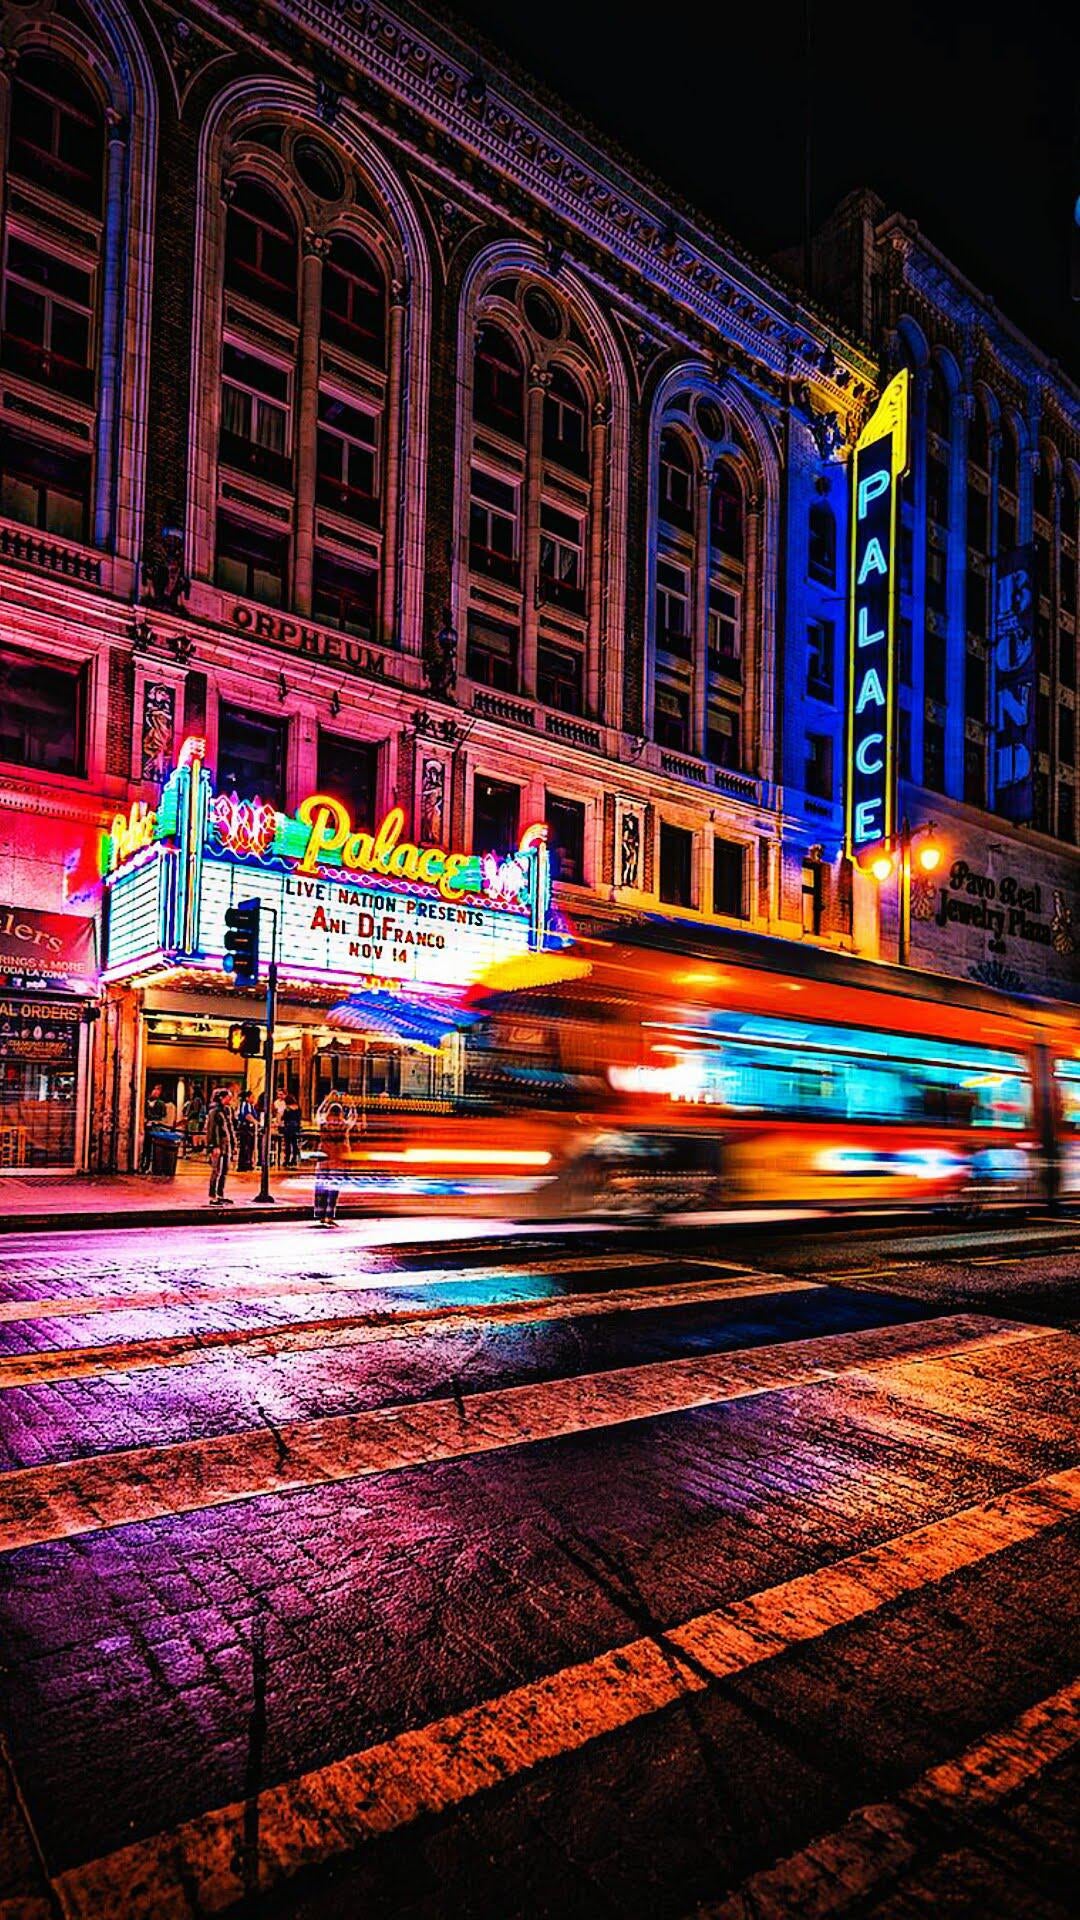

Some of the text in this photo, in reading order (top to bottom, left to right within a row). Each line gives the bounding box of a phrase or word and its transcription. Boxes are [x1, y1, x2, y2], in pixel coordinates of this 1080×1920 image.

[232, 606, 385, 675] ORPHEUM
[855, 469, 890, 843] PALACE
[298, 794, 471, 900] Palace
[285, 878, 485, 927] LIVE NATION PRESENTS
[949, 861, 1042, 914] Pavo Real
[0, 913, 63, 953] lers
[936, 888, 1007, 954] Jewelry
[348, 941, 408, 964] NOV 14
[20, 1004, 79, 1021] ORDERS
